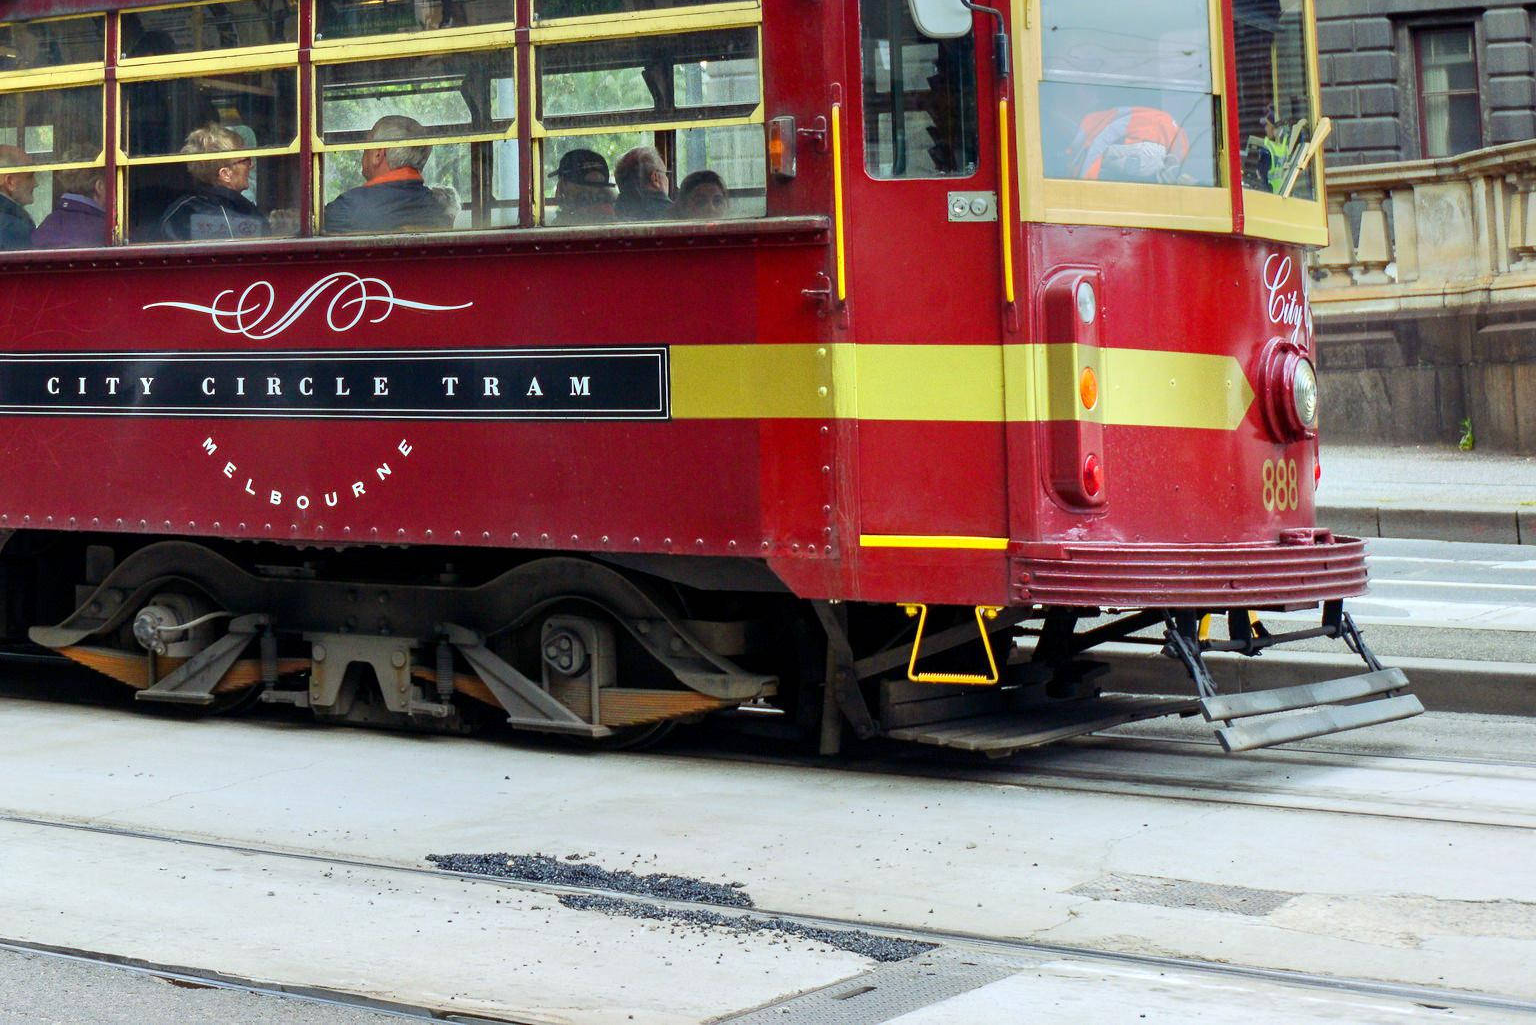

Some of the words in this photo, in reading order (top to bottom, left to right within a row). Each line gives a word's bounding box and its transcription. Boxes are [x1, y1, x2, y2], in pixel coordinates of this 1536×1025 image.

[1264, 253, 1303, 346] City
[46, 376, 154, 396] CITY
[201, 376, 390, 396] CIRCLE
[442, 375, 592, 396] TRAM
[202, 438, 412, 509] MELBOURNE
[1263, 459, 1299, 512] 888
